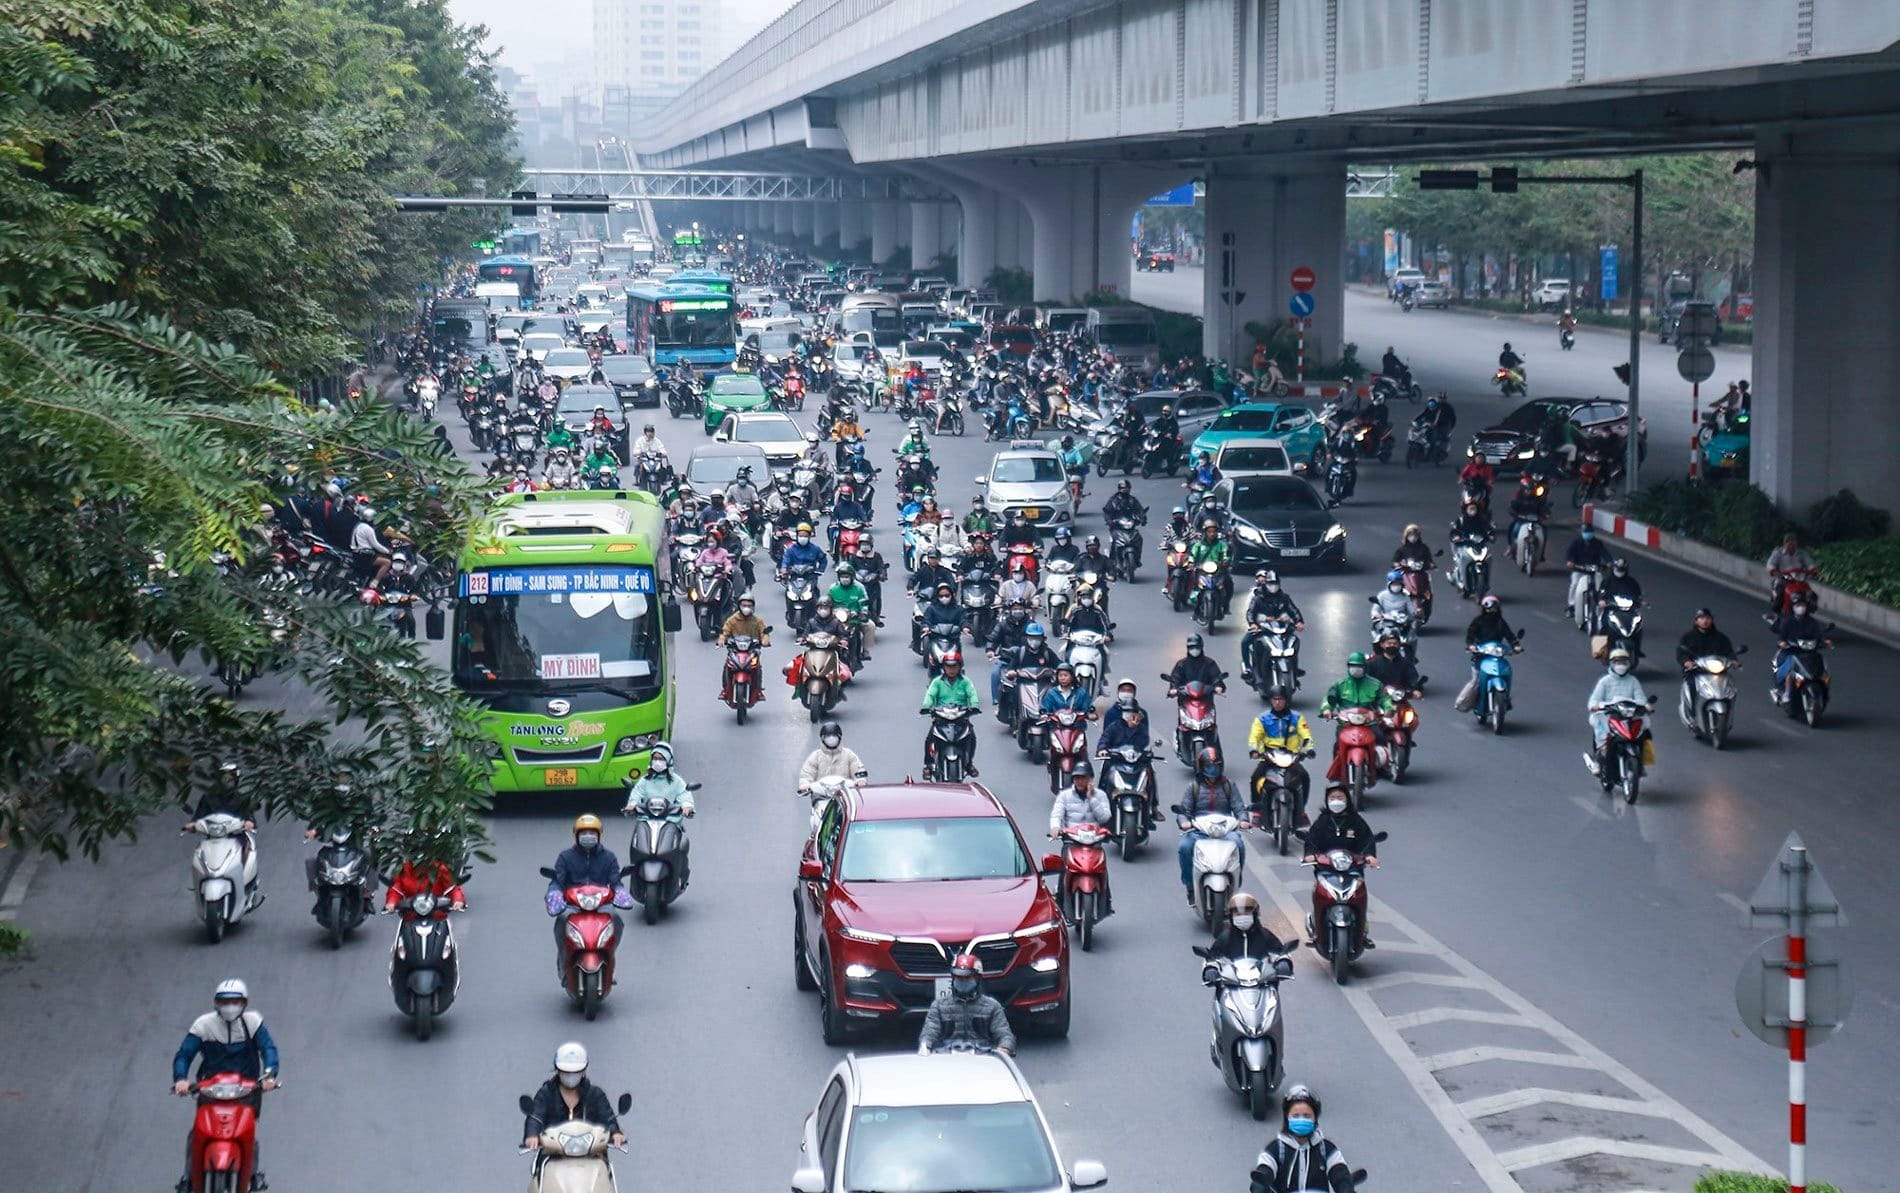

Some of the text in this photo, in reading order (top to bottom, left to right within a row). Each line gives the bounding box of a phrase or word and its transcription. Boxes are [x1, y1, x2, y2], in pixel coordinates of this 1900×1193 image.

[471, 577, 487, 591] 212
[504, 573, 523, 591] ĐÌNH
[529, 575, 546, 591] SAM
[547, 575, 567, 590] SUNG
[573, 575, 583, 590] TP
[600, 574, 619, 590] NINH
[625, 569, 639, 591] QUẾ
[567, 655, 597, 676] ĐÌNH
